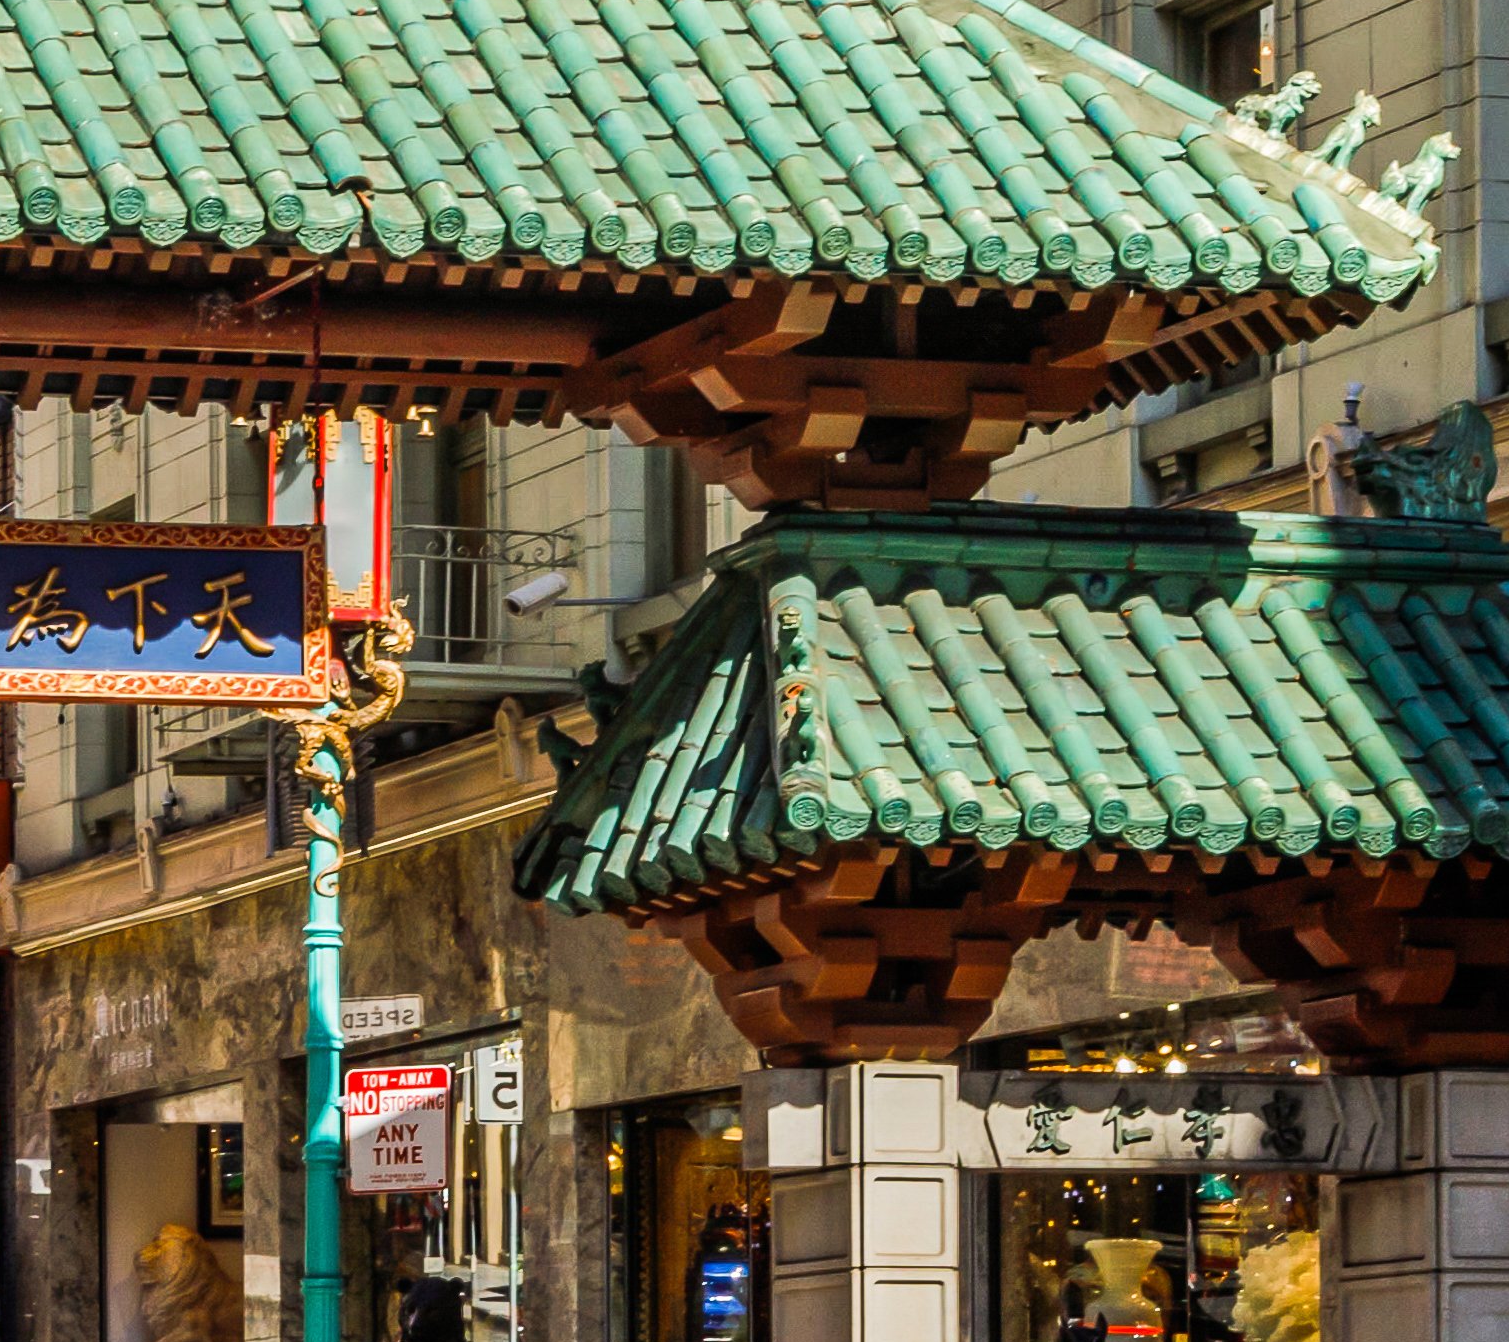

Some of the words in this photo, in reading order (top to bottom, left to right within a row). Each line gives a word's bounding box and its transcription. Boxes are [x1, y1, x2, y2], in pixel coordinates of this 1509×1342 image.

[362, 1071, 433, 1088] TOW-AWAY
[349, 1090, 378, 1115] NO
[382, 1093, 445, 1113] STOPPING
[376, 1123, 419, 1144] ANY
[373, 1145, 424, 1166] TIME
